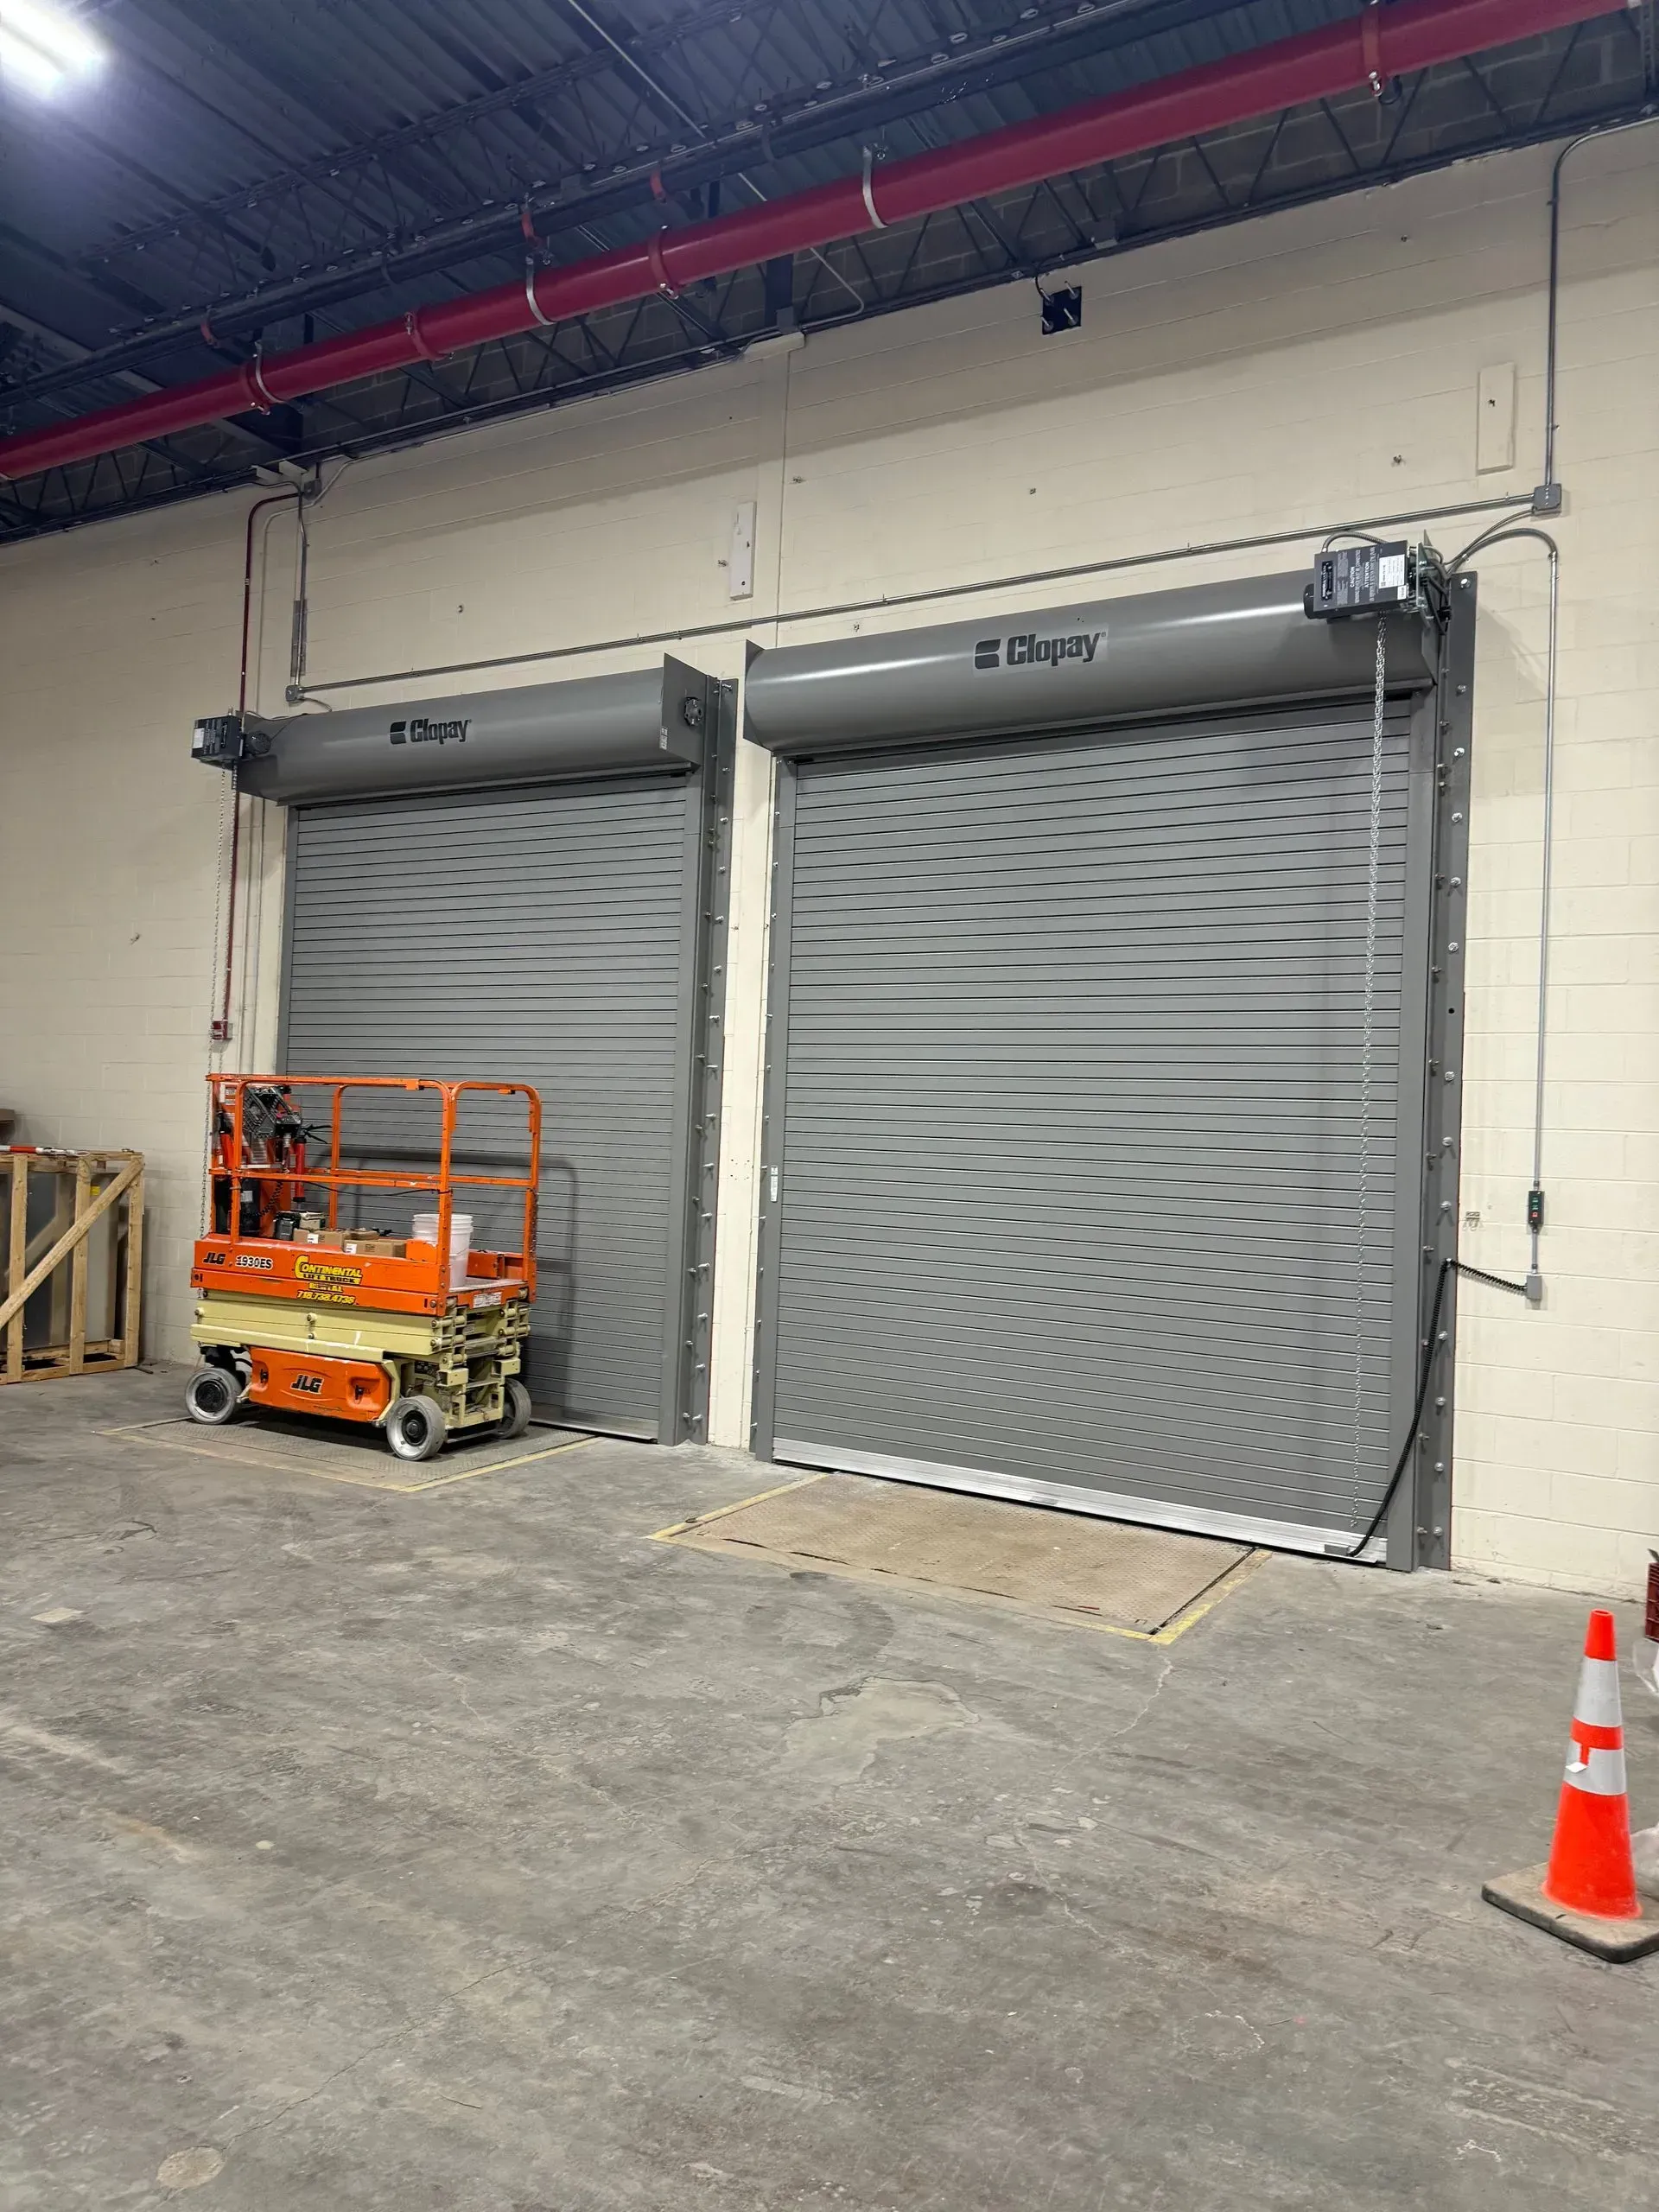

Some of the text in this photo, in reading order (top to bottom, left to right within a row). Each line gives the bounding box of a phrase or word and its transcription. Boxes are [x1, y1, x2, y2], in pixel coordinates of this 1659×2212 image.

[1007, 632, 1102, 666] Clopay
[410, 718, 469, 745] Clopay
[202, 1252, 226, 1265] JLG
[235, 1255, 272, 1269] 1930ES
[295, 1255, 362, 1279] CONTINENTAL
[290, 1374, 324, 1395] JLG
